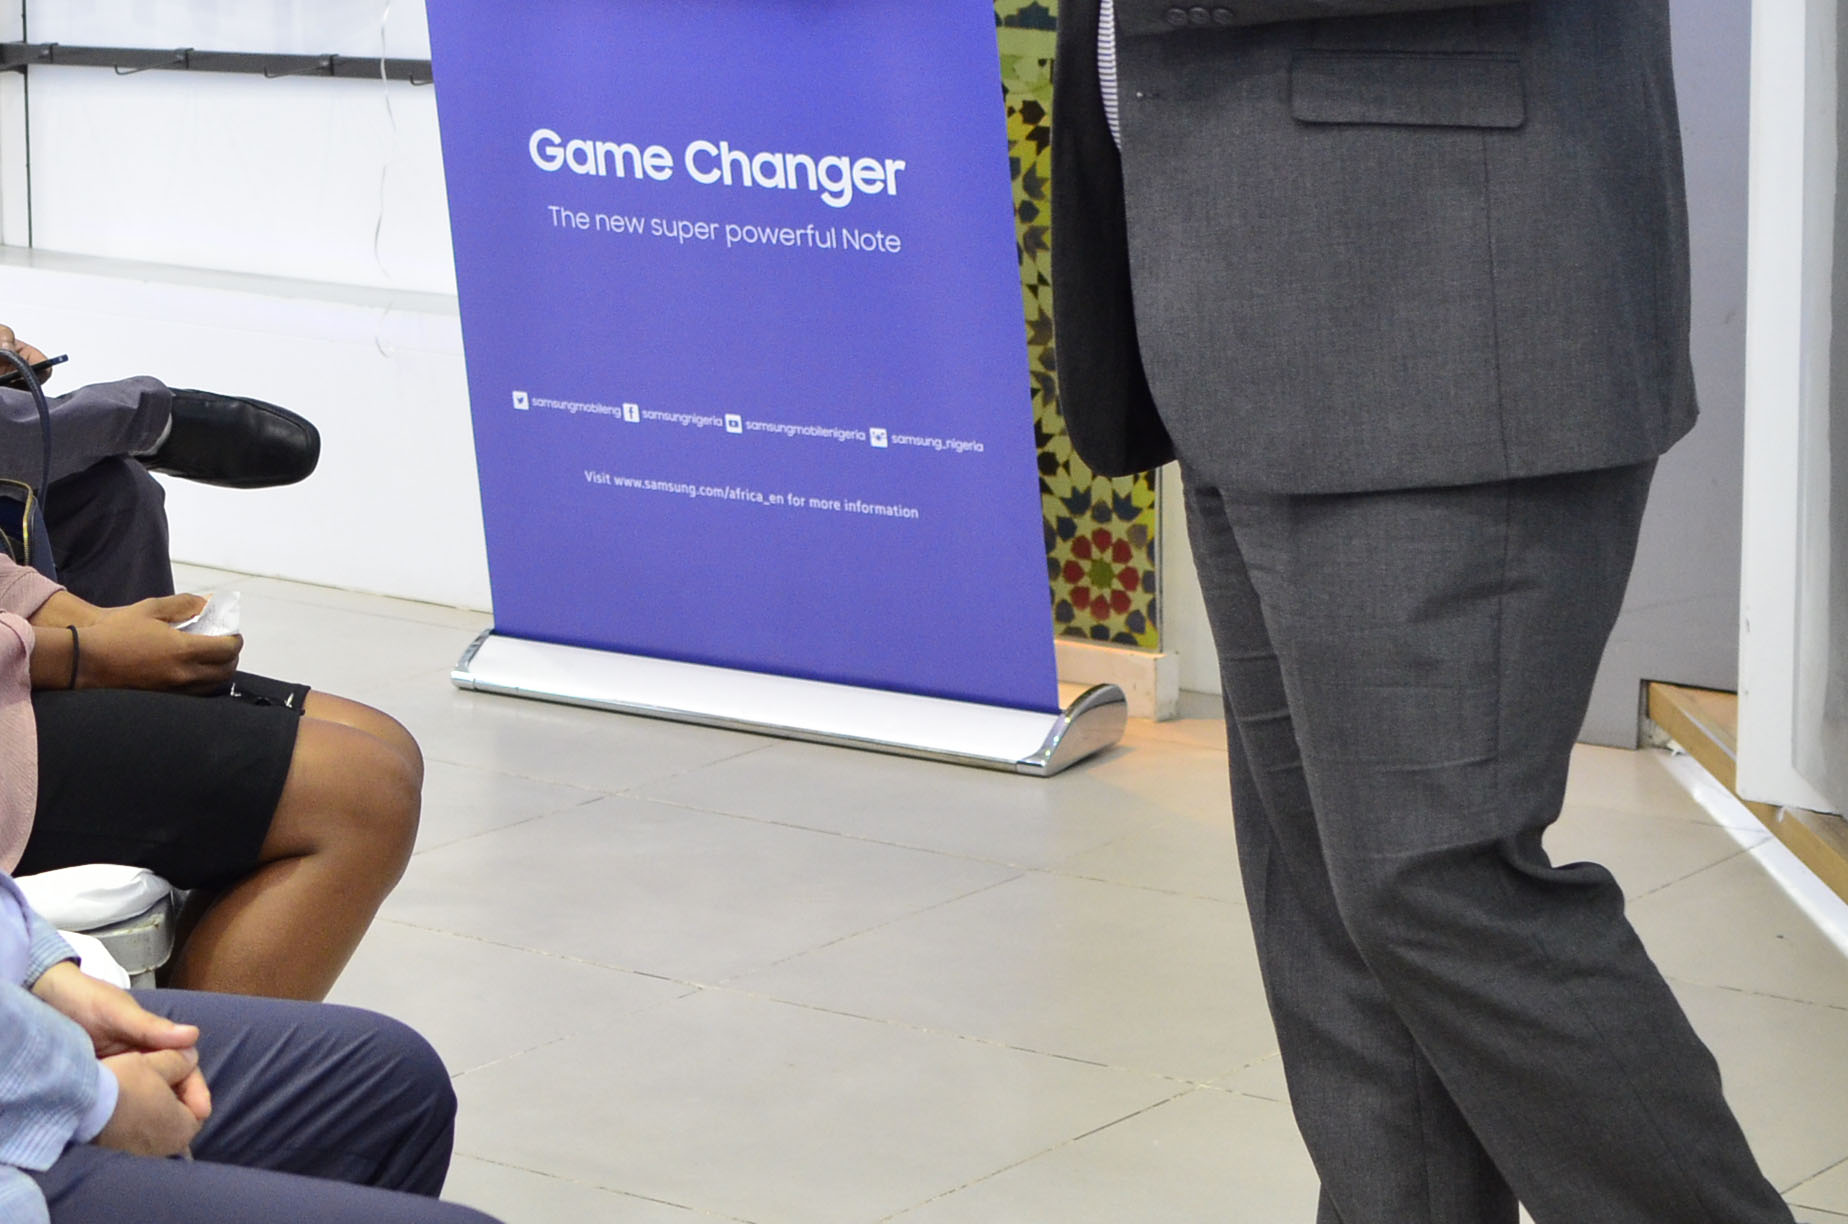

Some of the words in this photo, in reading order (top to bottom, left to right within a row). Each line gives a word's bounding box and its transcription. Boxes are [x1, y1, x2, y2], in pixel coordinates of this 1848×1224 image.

[529, 128, 674, 181] Game
[684, 140, 906, 208] Changer
[548, 205, 590, 230] The
[595, 214, 645, 235] new
[651, 216, 719, 244] super
[725, 222, 837, 249] powerful
[841, 228, 901, 253] Note
[642, 408, 723, 428] samsungnigeria
[584, 470, 611, 486] Visit
[614, 475, 784, 506] www.samsung.com/africa_en
[787, 493, 805, 507] for
[809, 497, 841, 511] more
[844, 500, 919, 519] information
